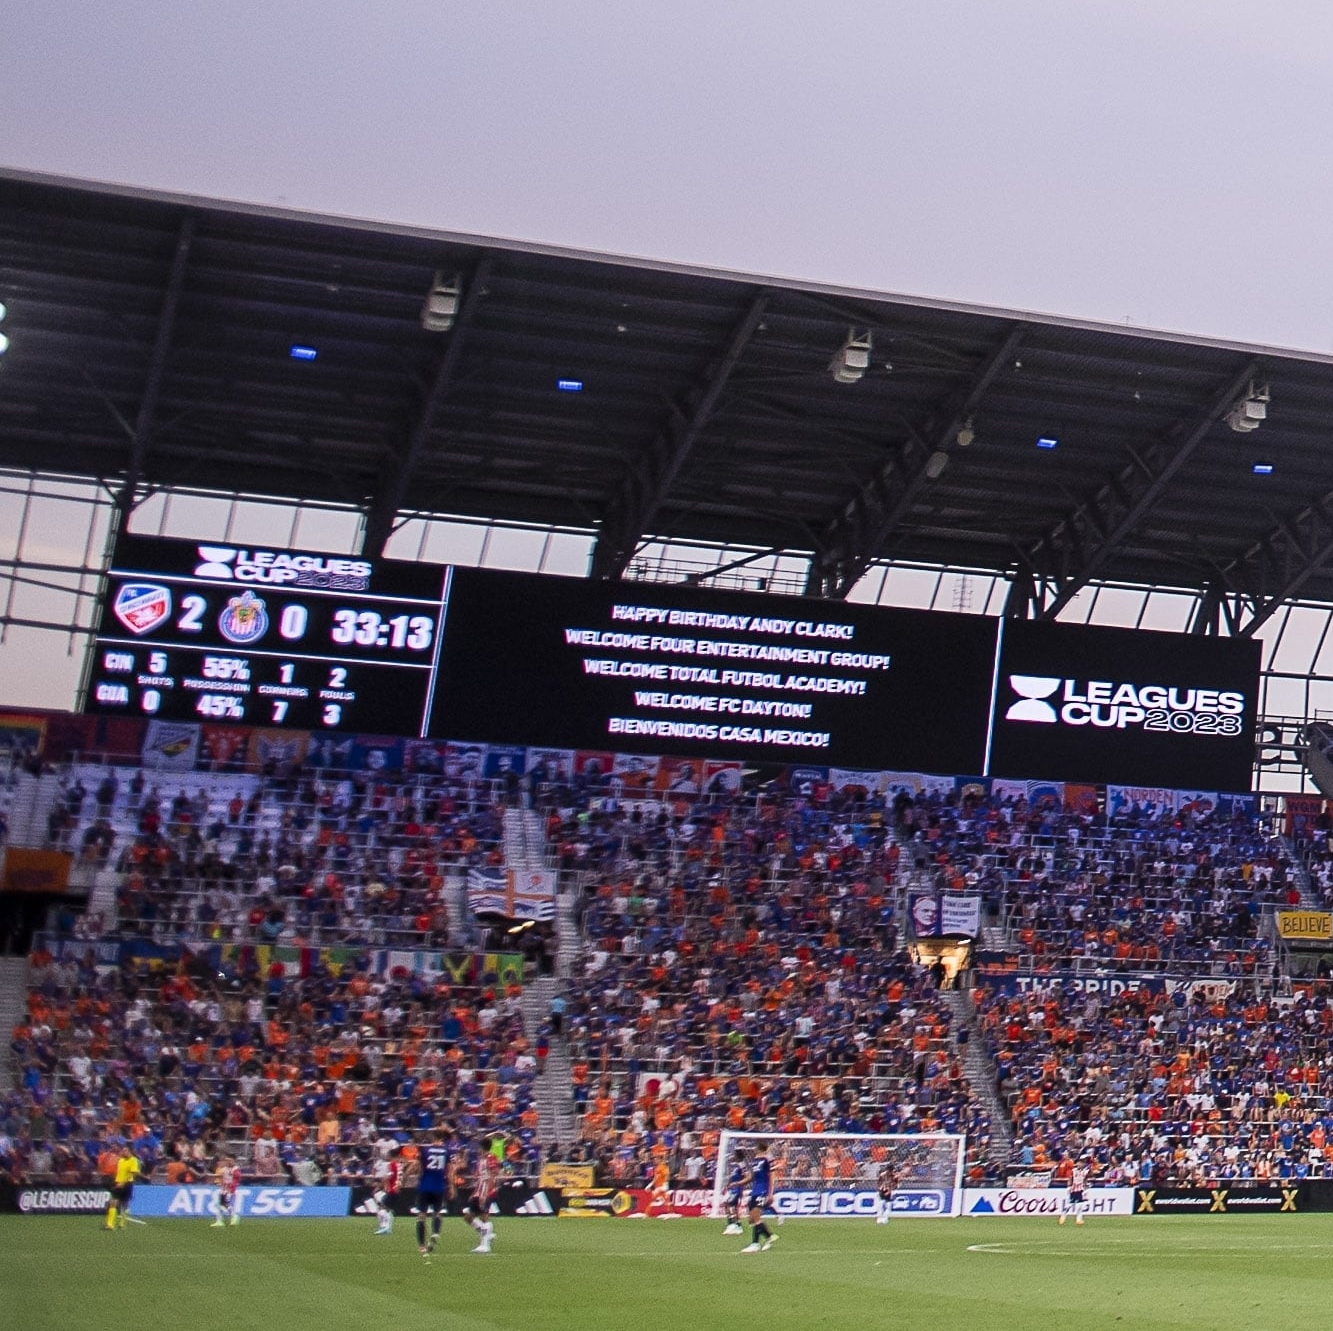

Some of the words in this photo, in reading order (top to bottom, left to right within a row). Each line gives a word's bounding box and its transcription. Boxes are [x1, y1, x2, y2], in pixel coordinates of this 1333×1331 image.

[237, 551, 371, 577] LEAGUES
[235, 567, 298, 583] CUP
[295, 573, 370, 591] 2023
[177, 596, 207, 630] 2
[280, 605, 308, 639] 0
[331, 610, 433, 649] 33:13
[612, 605, 669, 623] HAPPY
[669, 609, 751, 629] BIRTHDAY
[749, 617, 795, 635] ANDY
[795, 621, 854, 640] CLARK!
[565, 629, 650, 650] WELCOME
[650, 636, 695, 654] FOUR
[696, 640, 831, 665] ENTERTAINMENT
[831, 651, 890, 670] GROUP!
[149, 652, 167, 673] 5
[203, 655, 250, 680] 55%
[280, 663, 295, 684] 1
[328, 667, 347, 688] 2
[583, 659, 668, 679] WELCOME
[669, 666, 721, 684] TOTAL
[722, 670, 785, 689] FUTBOL
[784, 676, 867, 696] ACADEMY!
[141, 690, 160, 713] 0
[197, 694, 244, 718] 45%
[272, 701, 288, 723] 7
[323, 704, 341, 725] 3
[635, 692, 718, 711] WELCOME
[718, 698, 740, 713] FC
[741, 699, 812, 718] DAYTON!
[1063, 679, 1245, 714] LEAGUES
[608, 718, 718, 740] BIENVENIDOS
[719, 725, 761, 743] CASA
[763, 729, 830, 747] MEXICO!
[1061, 703, 1146, 729] CUP
[1144, 710, 1242, 736] 2023
[1123, 787, 1174, 805] NORDEN
[1282, 915, 1331, 934] BELIEVE
[427, 1155, 446, 1169] 21
[19, 1190, 110, 1210] @LEAGUESCUP
[168, 1188, 249, 1213] AT&T
[251, 1189, 304, 1213] 5G
[772, 1190, 880, 1214] GEICO
[1000, 1190, 1058, 1213] Coors
